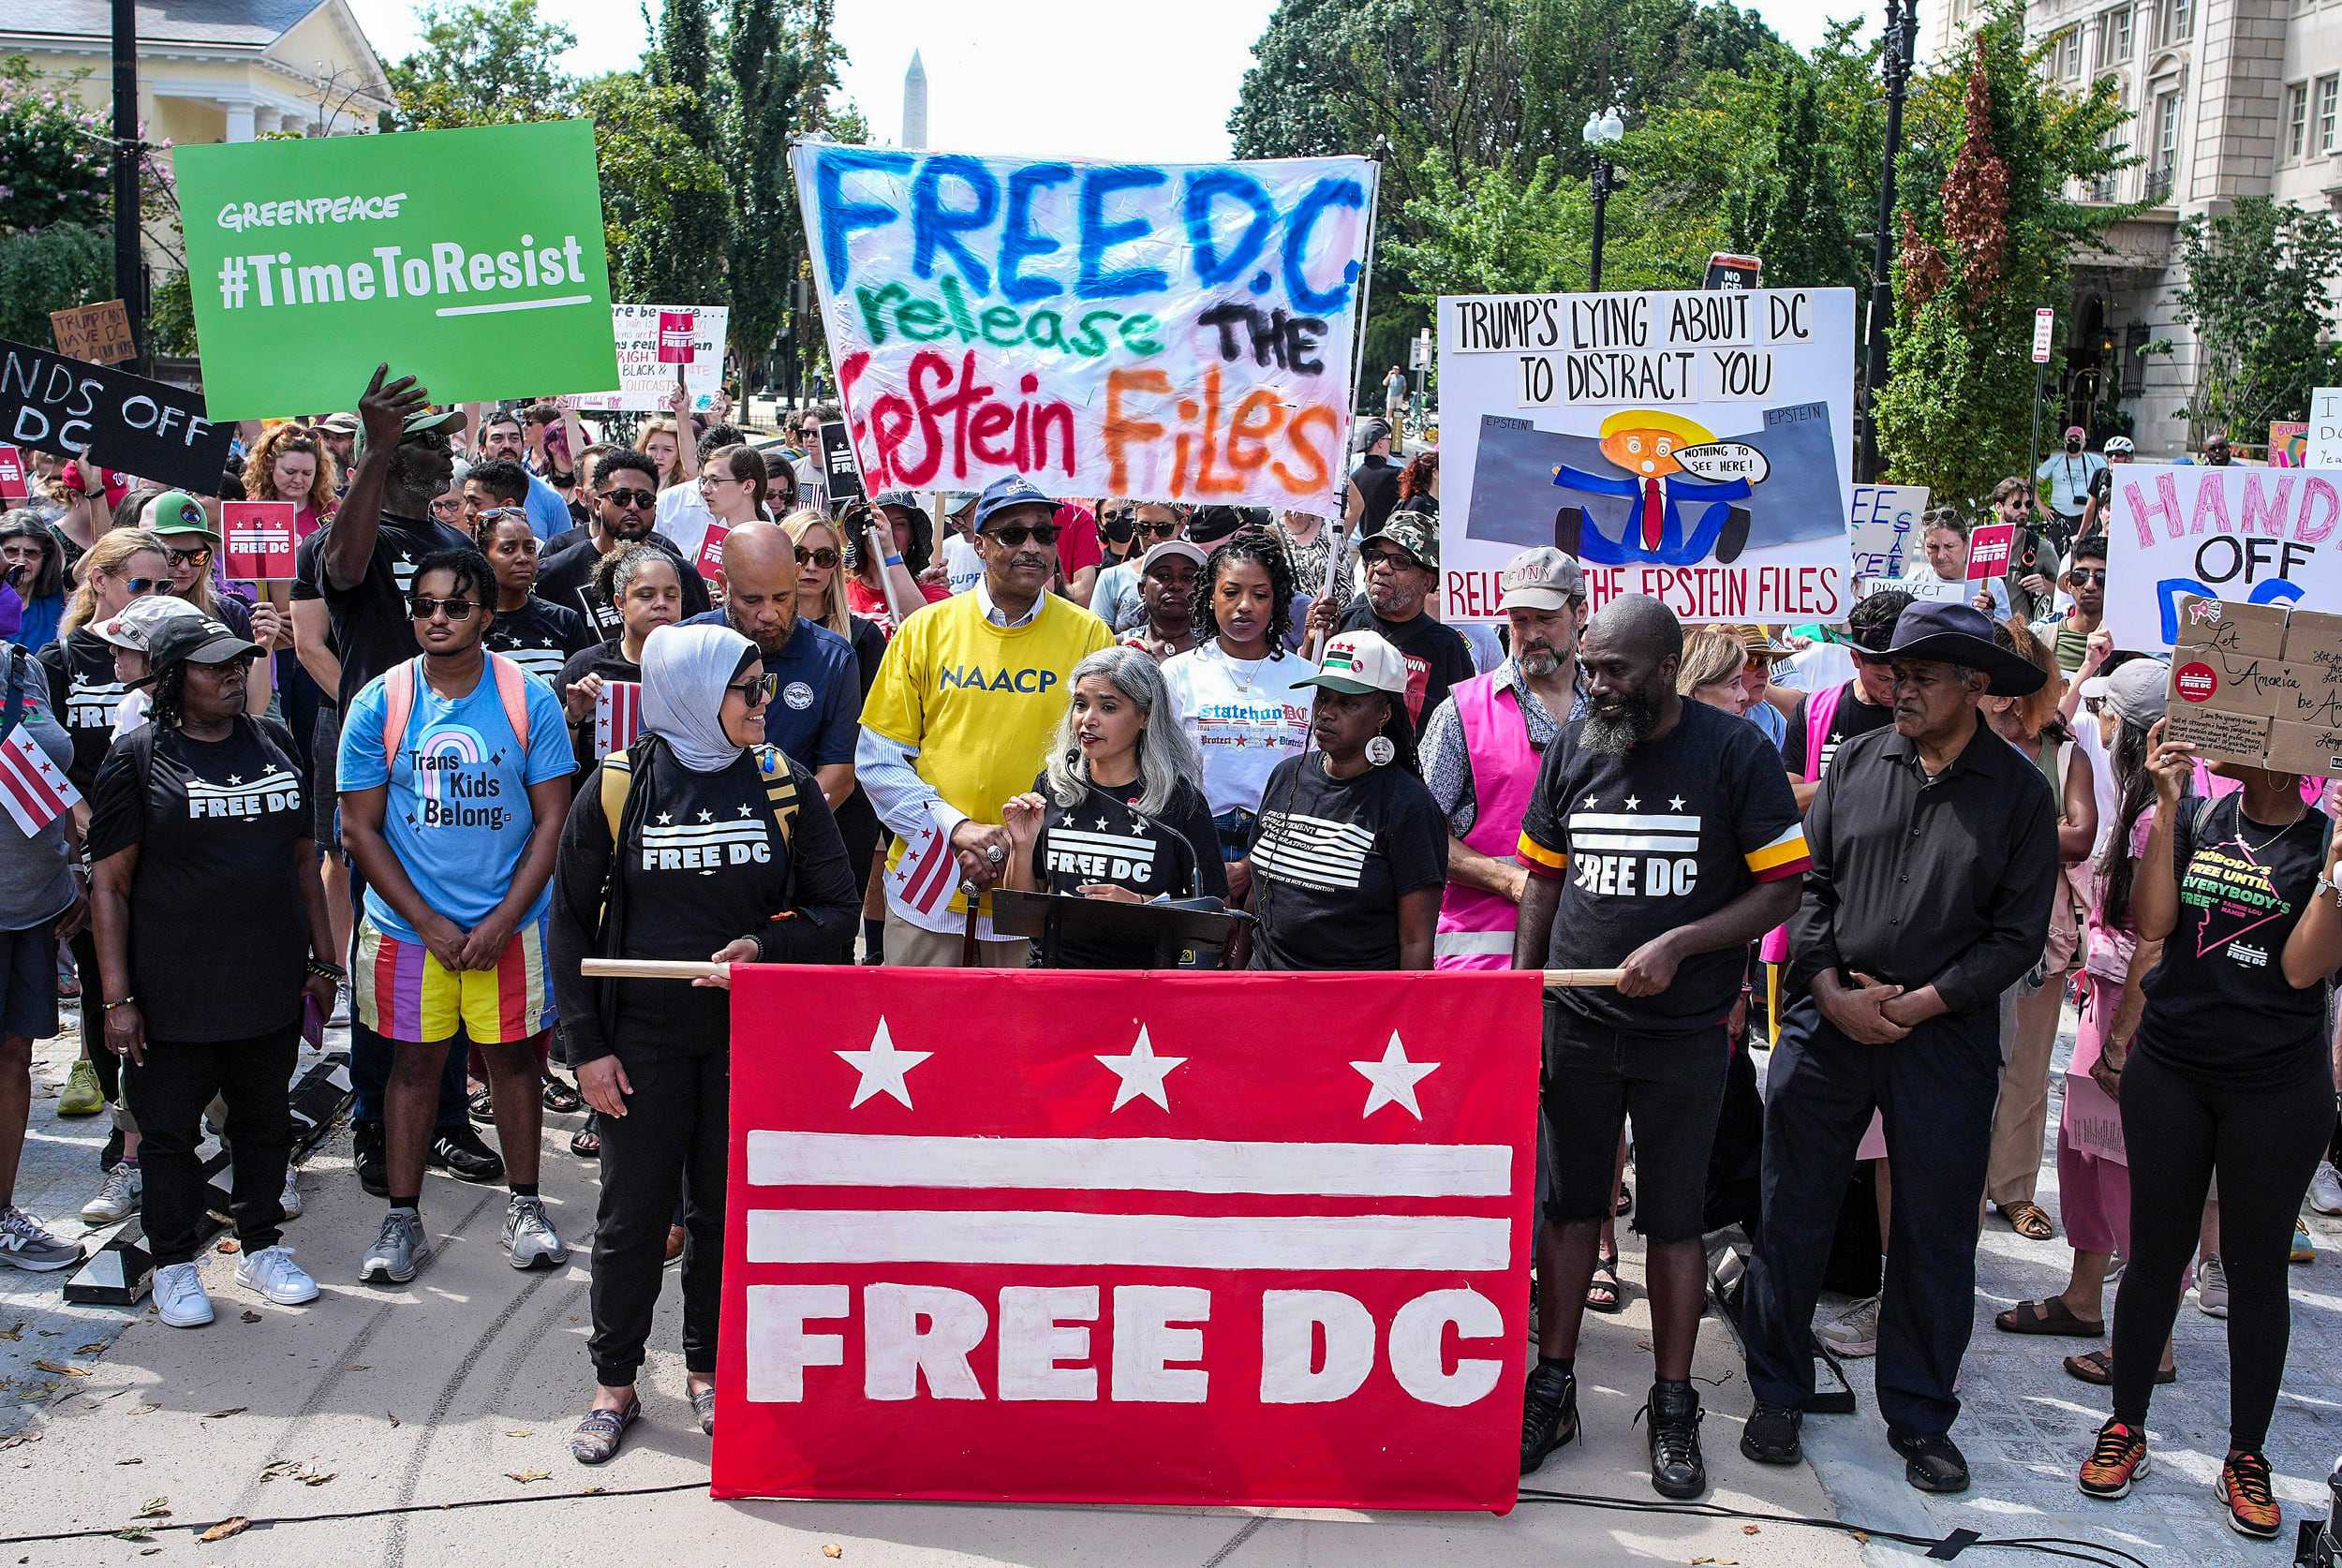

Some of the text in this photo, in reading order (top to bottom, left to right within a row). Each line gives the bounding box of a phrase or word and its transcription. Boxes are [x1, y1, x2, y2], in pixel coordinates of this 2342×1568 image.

[217, 192, 408, 232] GREENPEACE
[816, 151, 1167, 305] FREE
[218, 234, 586, 309] #TimeToResist
[1725, 271, 1741, 283] NO
[55, 312, 98, 332] TRUMP
[59, 322, 125, 347] HAVE DC
[856, 275, 1328, 375] release THE
[1456, 293, 1809, 349] TRUMP'S LYING ABOUT DC
[662, 339, 687, 348] FREE
[623, 363, 655, 377] BLACK
[1520, 350, 1772, 403] TO DISTRACT YOU
[1, 351, 215, 446] NDS OFF
[14, 405, 93, 453] DC
[1486, 416, 1529, 431] EPSTEIN
[1769, 406, 1821, 426] EPSTEIN
[1684, 446, 1749, 459] NOTHING TO
[1691, 461, 1712, 472] SEE
[230, 542, 289, 554] FREE DC
[1972, 552, 2007, 563] FREE DC
[2195, 535, 2315, 584] OFF
[1507, 567, 1552, 581] FDNY
[1641, 568, 1746, 616] EPSTEIN
[1758, 567, 1838, 615] FILES
[2201, 620, 2241, 656] Let
[940, 666, 1058, 693] NAACP
[2298, 692, 2314, 709] be
[1201, 735, 1232, 746] Protect
[408, 750, 459, 770] Trans
[450, 772, 500, 798] Kids
[189, 791, 301, 819] FREE DC
[425, 799, 504, 830] Belong
[643, 842, 771, 870] FREE DC
[1046, 850, 1152, 883] FREE DC
[1574, 852, 1697, 896] FREE DC
[2188, 863, 2272, 892] FREE UNTIL
[2182, 876, 2291, 914] EVERYBODY'S
[2247, 907, 2262, 916] LOU
[2227, 950, 2267, 967] FREE DC
[746, 1280, 1504, 1407] FREE DC
